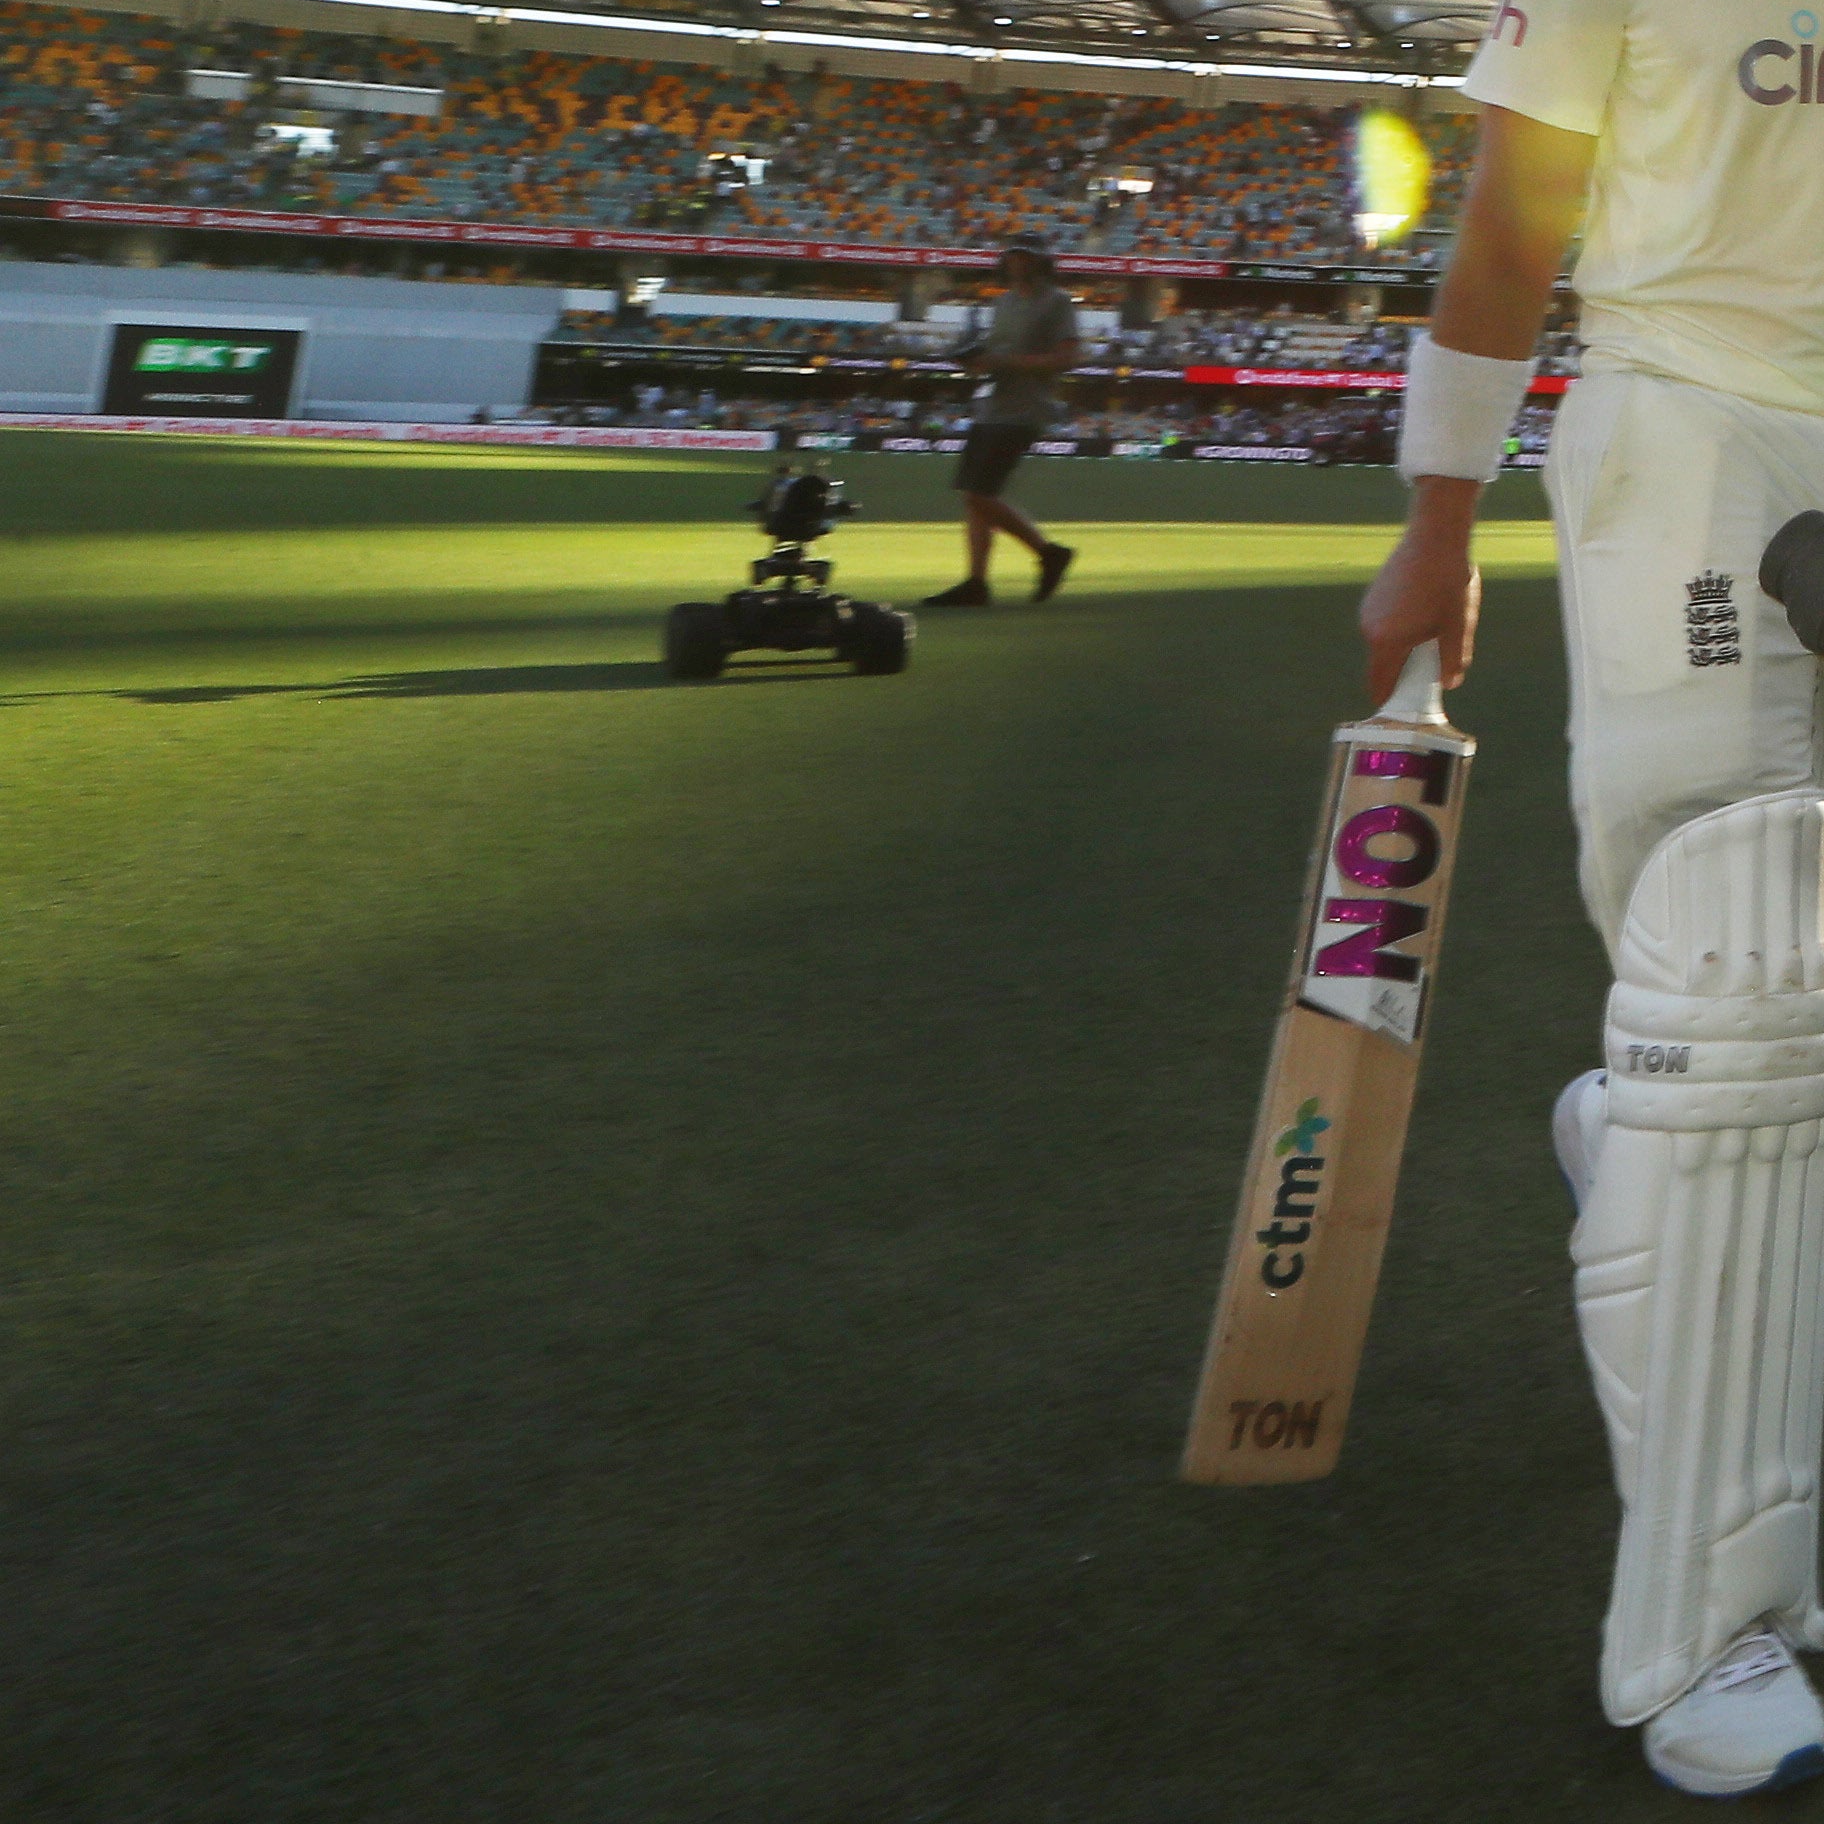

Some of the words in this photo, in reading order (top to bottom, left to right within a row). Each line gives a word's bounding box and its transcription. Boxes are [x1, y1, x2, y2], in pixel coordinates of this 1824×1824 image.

[1314, 747, 1453, 985] TON
[1626, 1044, 1691, 1075] TON
[1256, 1155, 1327, 1292] ctm
[1226, 1398, 1326, 1451] TON
